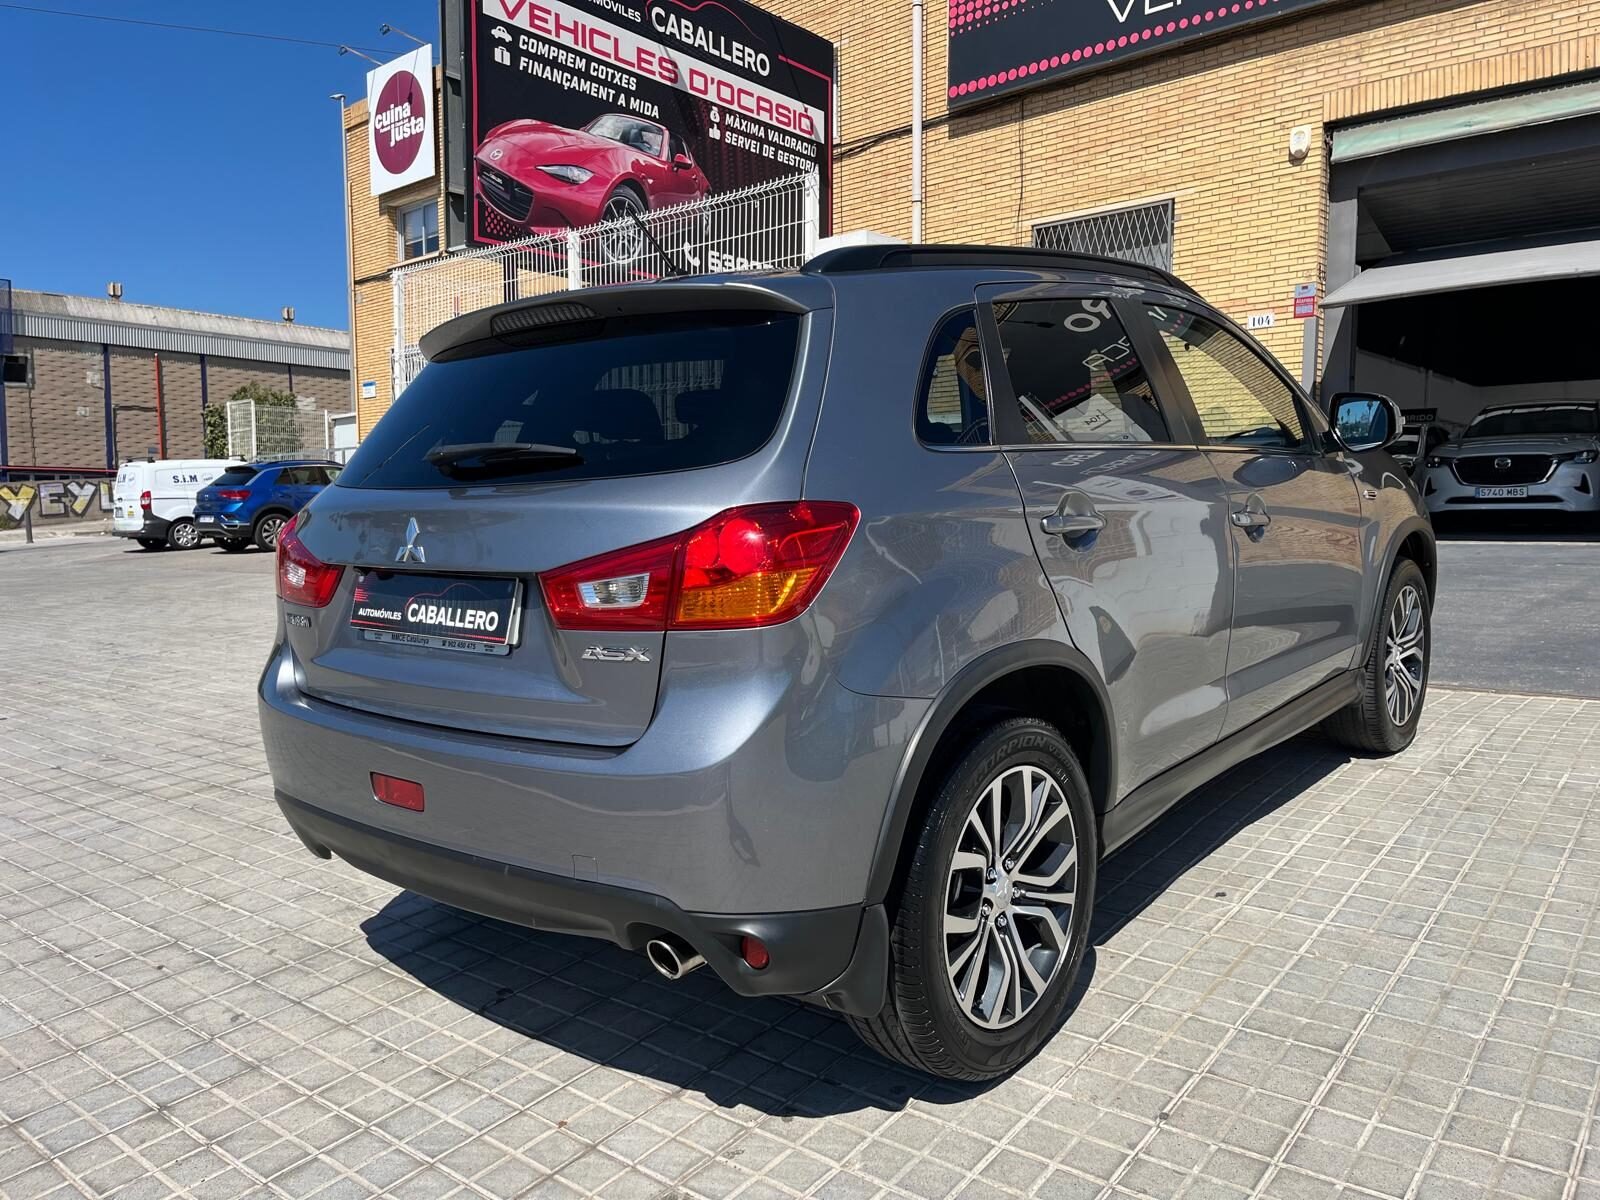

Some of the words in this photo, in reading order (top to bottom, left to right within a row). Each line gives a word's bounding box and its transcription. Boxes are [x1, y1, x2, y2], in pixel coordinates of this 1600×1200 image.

[500, 0, 679, 84] VEHICLES
[651, 6, 770, 77] CABALLERO
[519, 34, 586, 72] COMPREM
[590, 62, 637, 91] COTXES
[519, 56, 616, 103] FINANÇAMENT
[617, 93, 626, 107] A
[630, 97, 660, 119] MIDA
[375, 102, 411, 130] cuina
[390, 116, 424, 147] justa
[725, 113, 765, 139] MÀXIMA
[768, 128, 817, 157] VALORACIÓ
[725, 131, 760, 154] SERVEI
[762, 144, 775, 159] DE
[1252, 315, 1271, 327] 104
[1480, 487, 1504, 497] 5740
[358, 607, 402, 621] AUTOMÓVILES
[407, 603, 499, 632] CABALLERO
